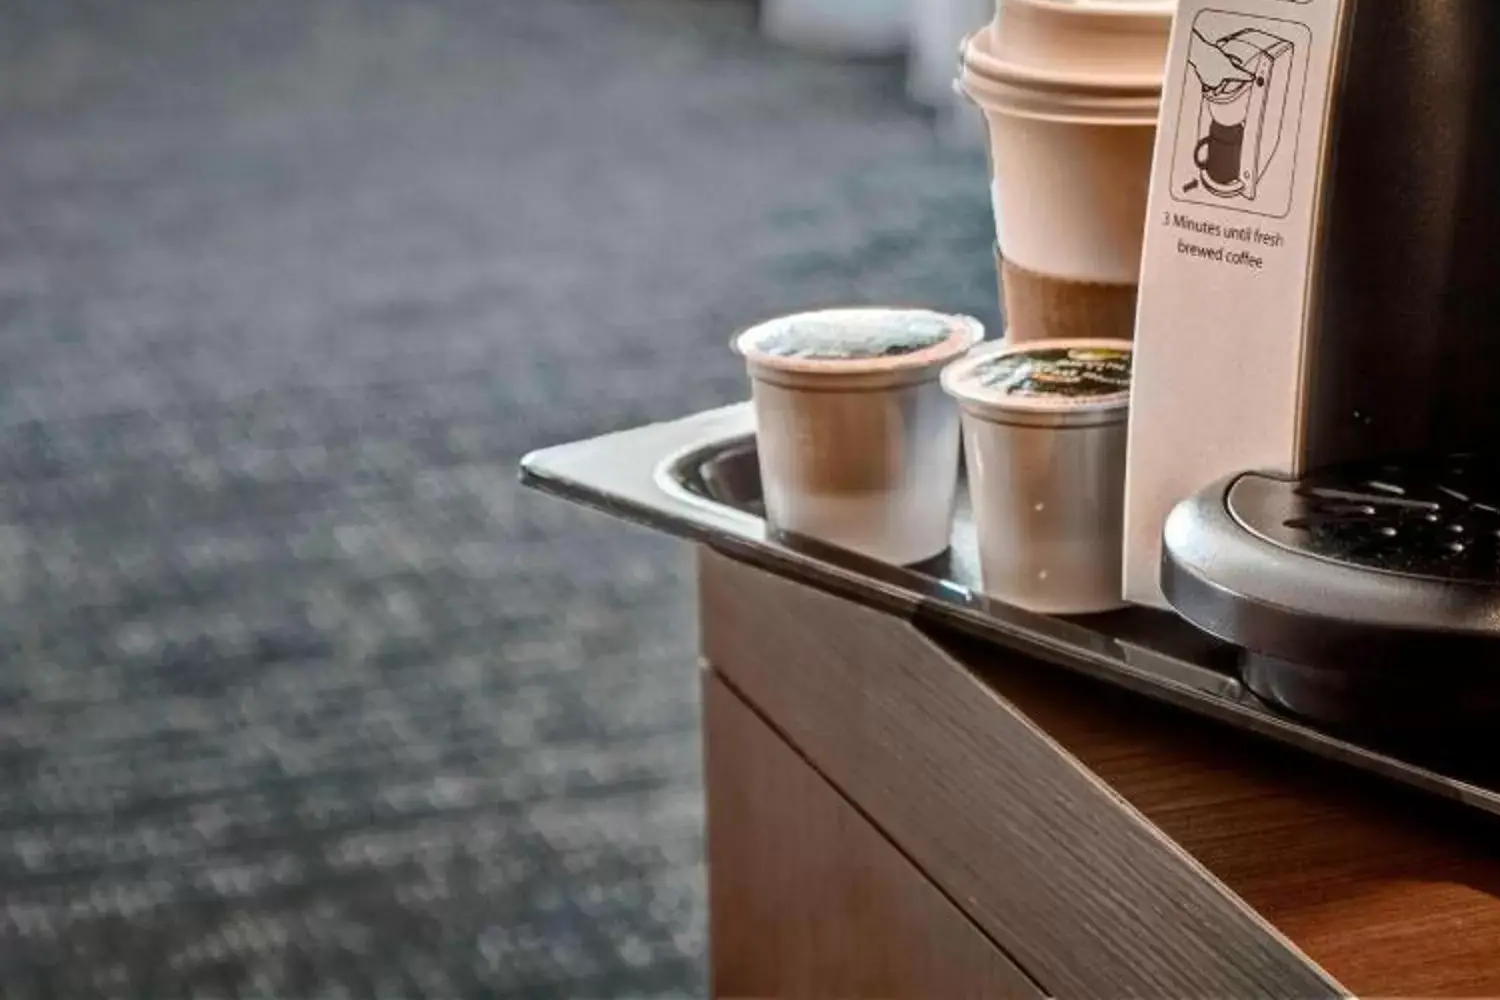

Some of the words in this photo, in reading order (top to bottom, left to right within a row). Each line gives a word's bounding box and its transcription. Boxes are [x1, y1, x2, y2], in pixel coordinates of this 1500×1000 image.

[1162, 210, 1170, 226] 3
[1172, 213, 1221, 237] Minutes
[1223, 227, 1252, 243] until
[1253, 228, 1284, 248] fresh
[1177, 238, 1223, 262] brewed
[1225, 251, 1263, 270] coffee
